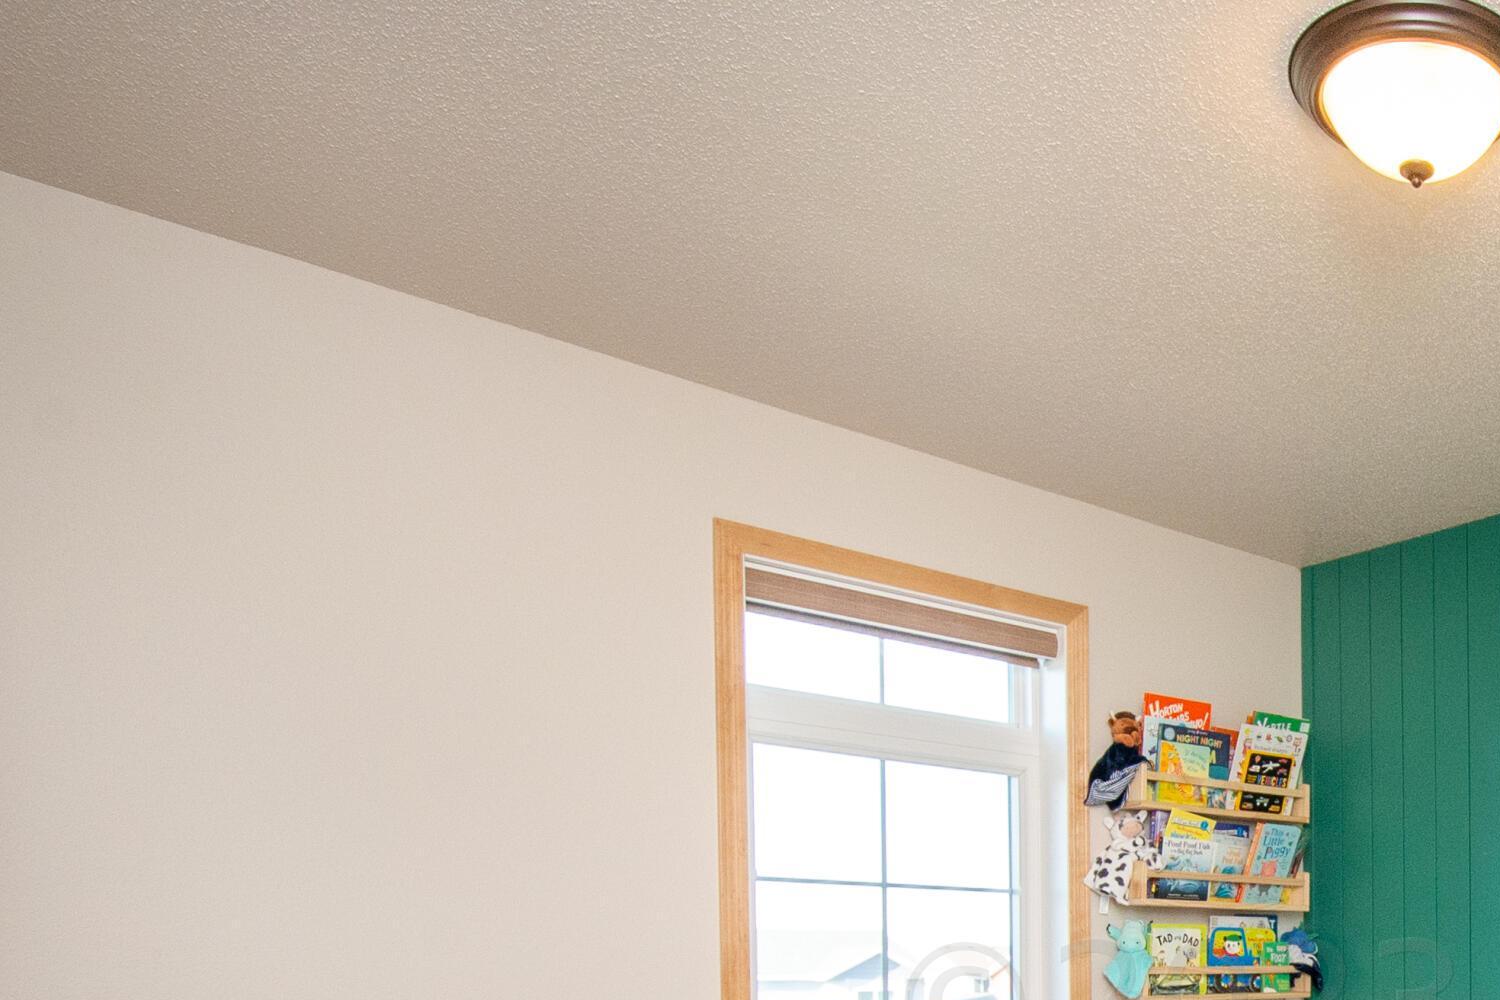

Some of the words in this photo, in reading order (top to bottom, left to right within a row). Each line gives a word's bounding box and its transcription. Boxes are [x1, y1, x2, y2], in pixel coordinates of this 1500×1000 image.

[1176, 734, 1200, 745] NIGHT
[1200, 738, 1223, 750] NIGHT
[1263, 836, 1286, 847] Little
[1264, 846, 1292, 860] Piggy
[1156, 933, 1173, 946] TAD
[1182, 933, 1200, 947] DAD
